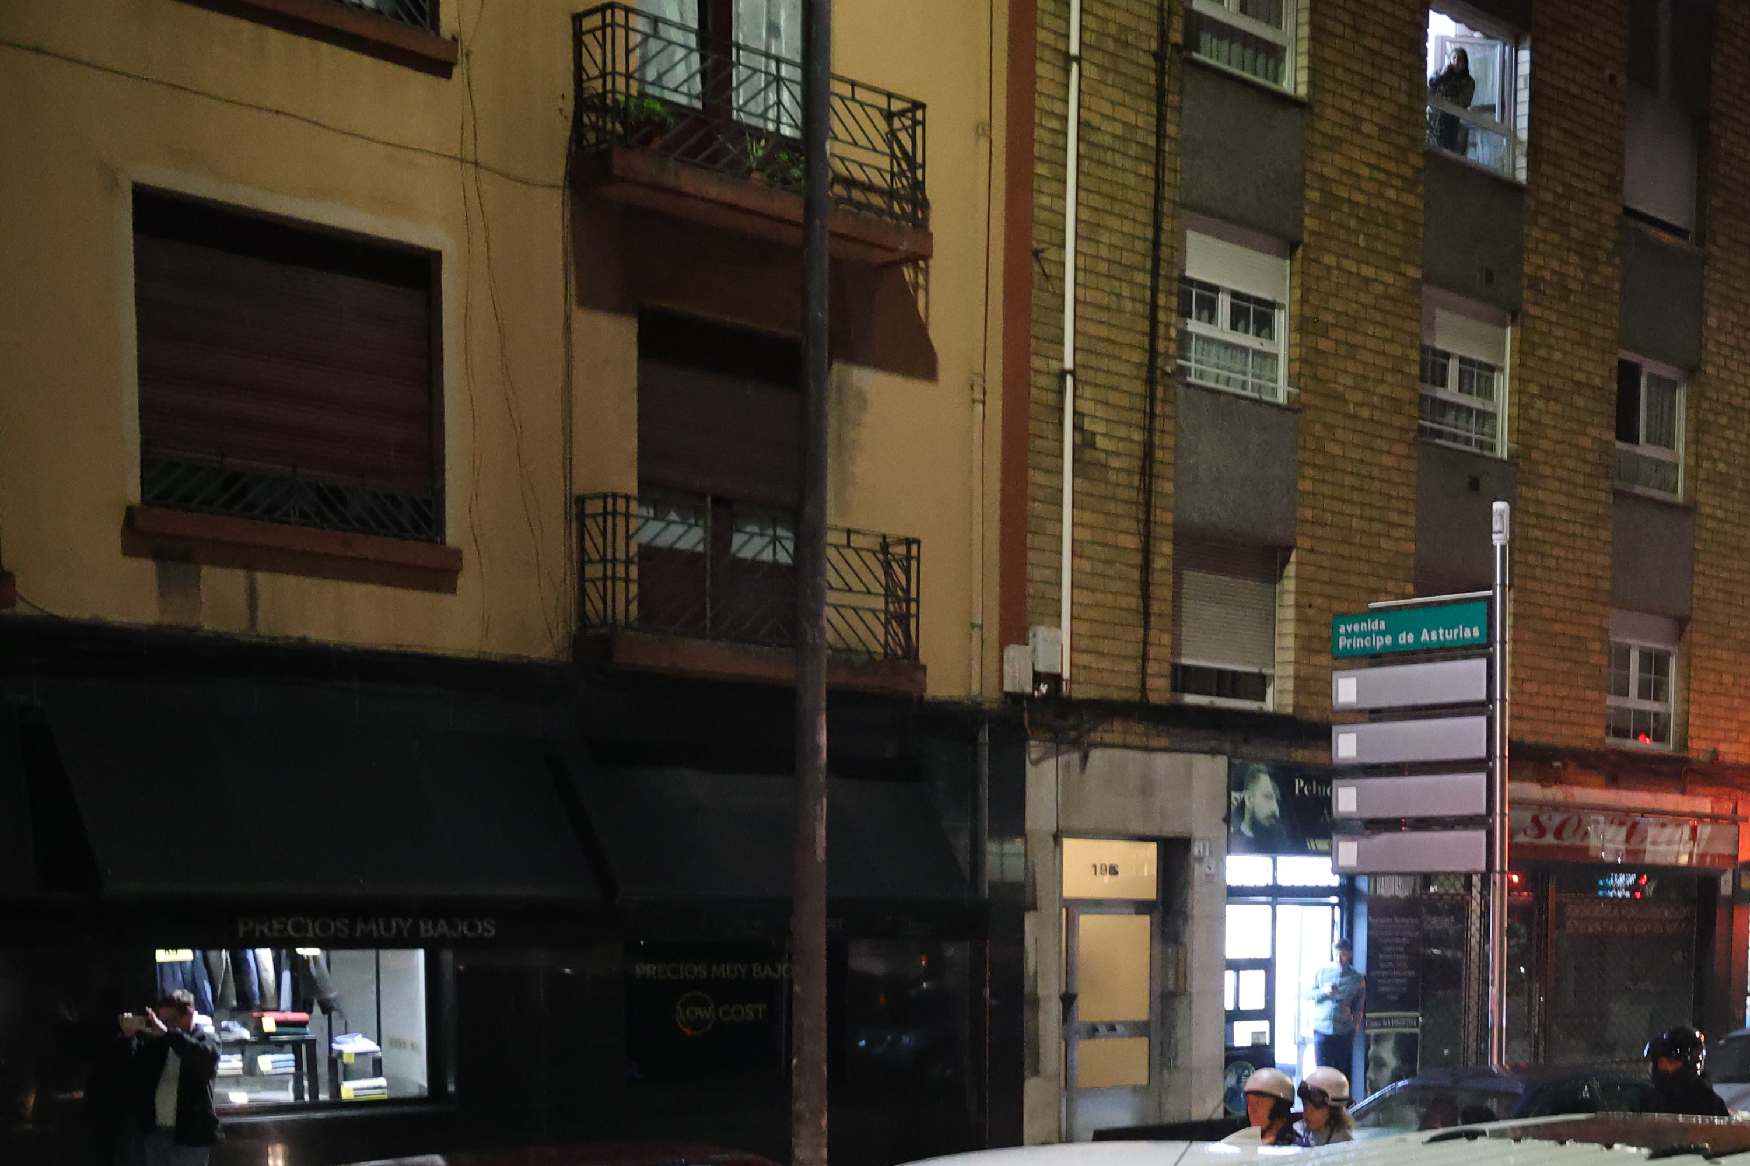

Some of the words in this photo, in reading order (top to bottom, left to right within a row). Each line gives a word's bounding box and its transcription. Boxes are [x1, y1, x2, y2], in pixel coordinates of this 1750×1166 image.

[1339, 618, 1386, 634] avenida
[1398, 630, 1415, 645] de
[1421, 624, 1480, 642] Asturias
[237, 917, 350, 938] PRECIOS
[356, 917, 412, 938] MUY
[418, 918, 497, 939] BAJOS
[635, 963, 708, 980] PRECIOS
[711, 964, 750, 980] MUY
[752, 964, 795, 980] BAJO
[678, 1006, 713, 1020] LOW
[719, 1003, 767, 1021] COST
